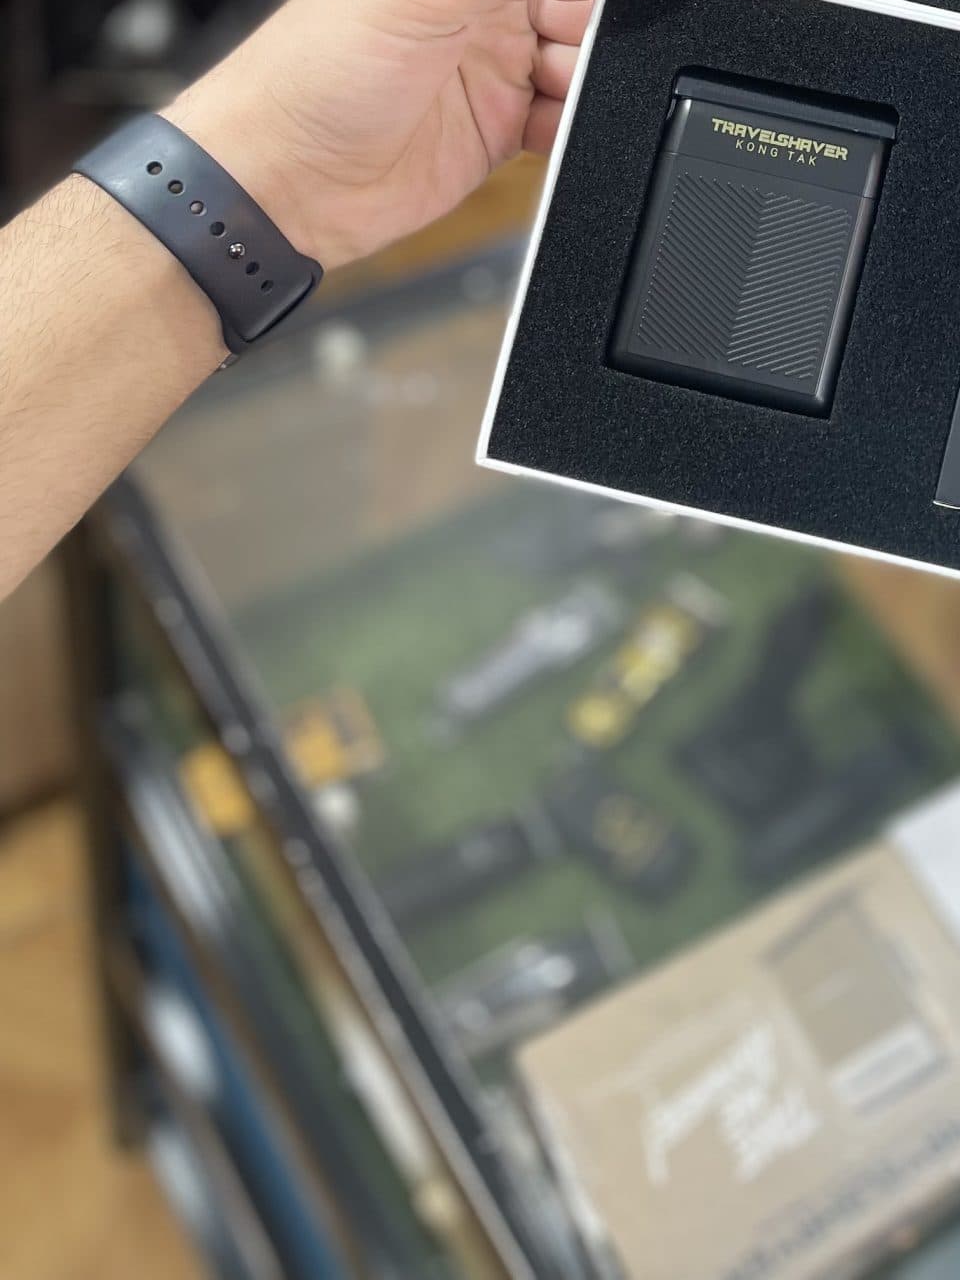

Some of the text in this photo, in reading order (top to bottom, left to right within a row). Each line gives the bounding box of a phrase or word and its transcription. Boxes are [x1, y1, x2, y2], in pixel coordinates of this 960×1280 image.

[711, 118, 849, 160] TRAVELSHAVER
[735, 139, 817, 167] KONG TAK
